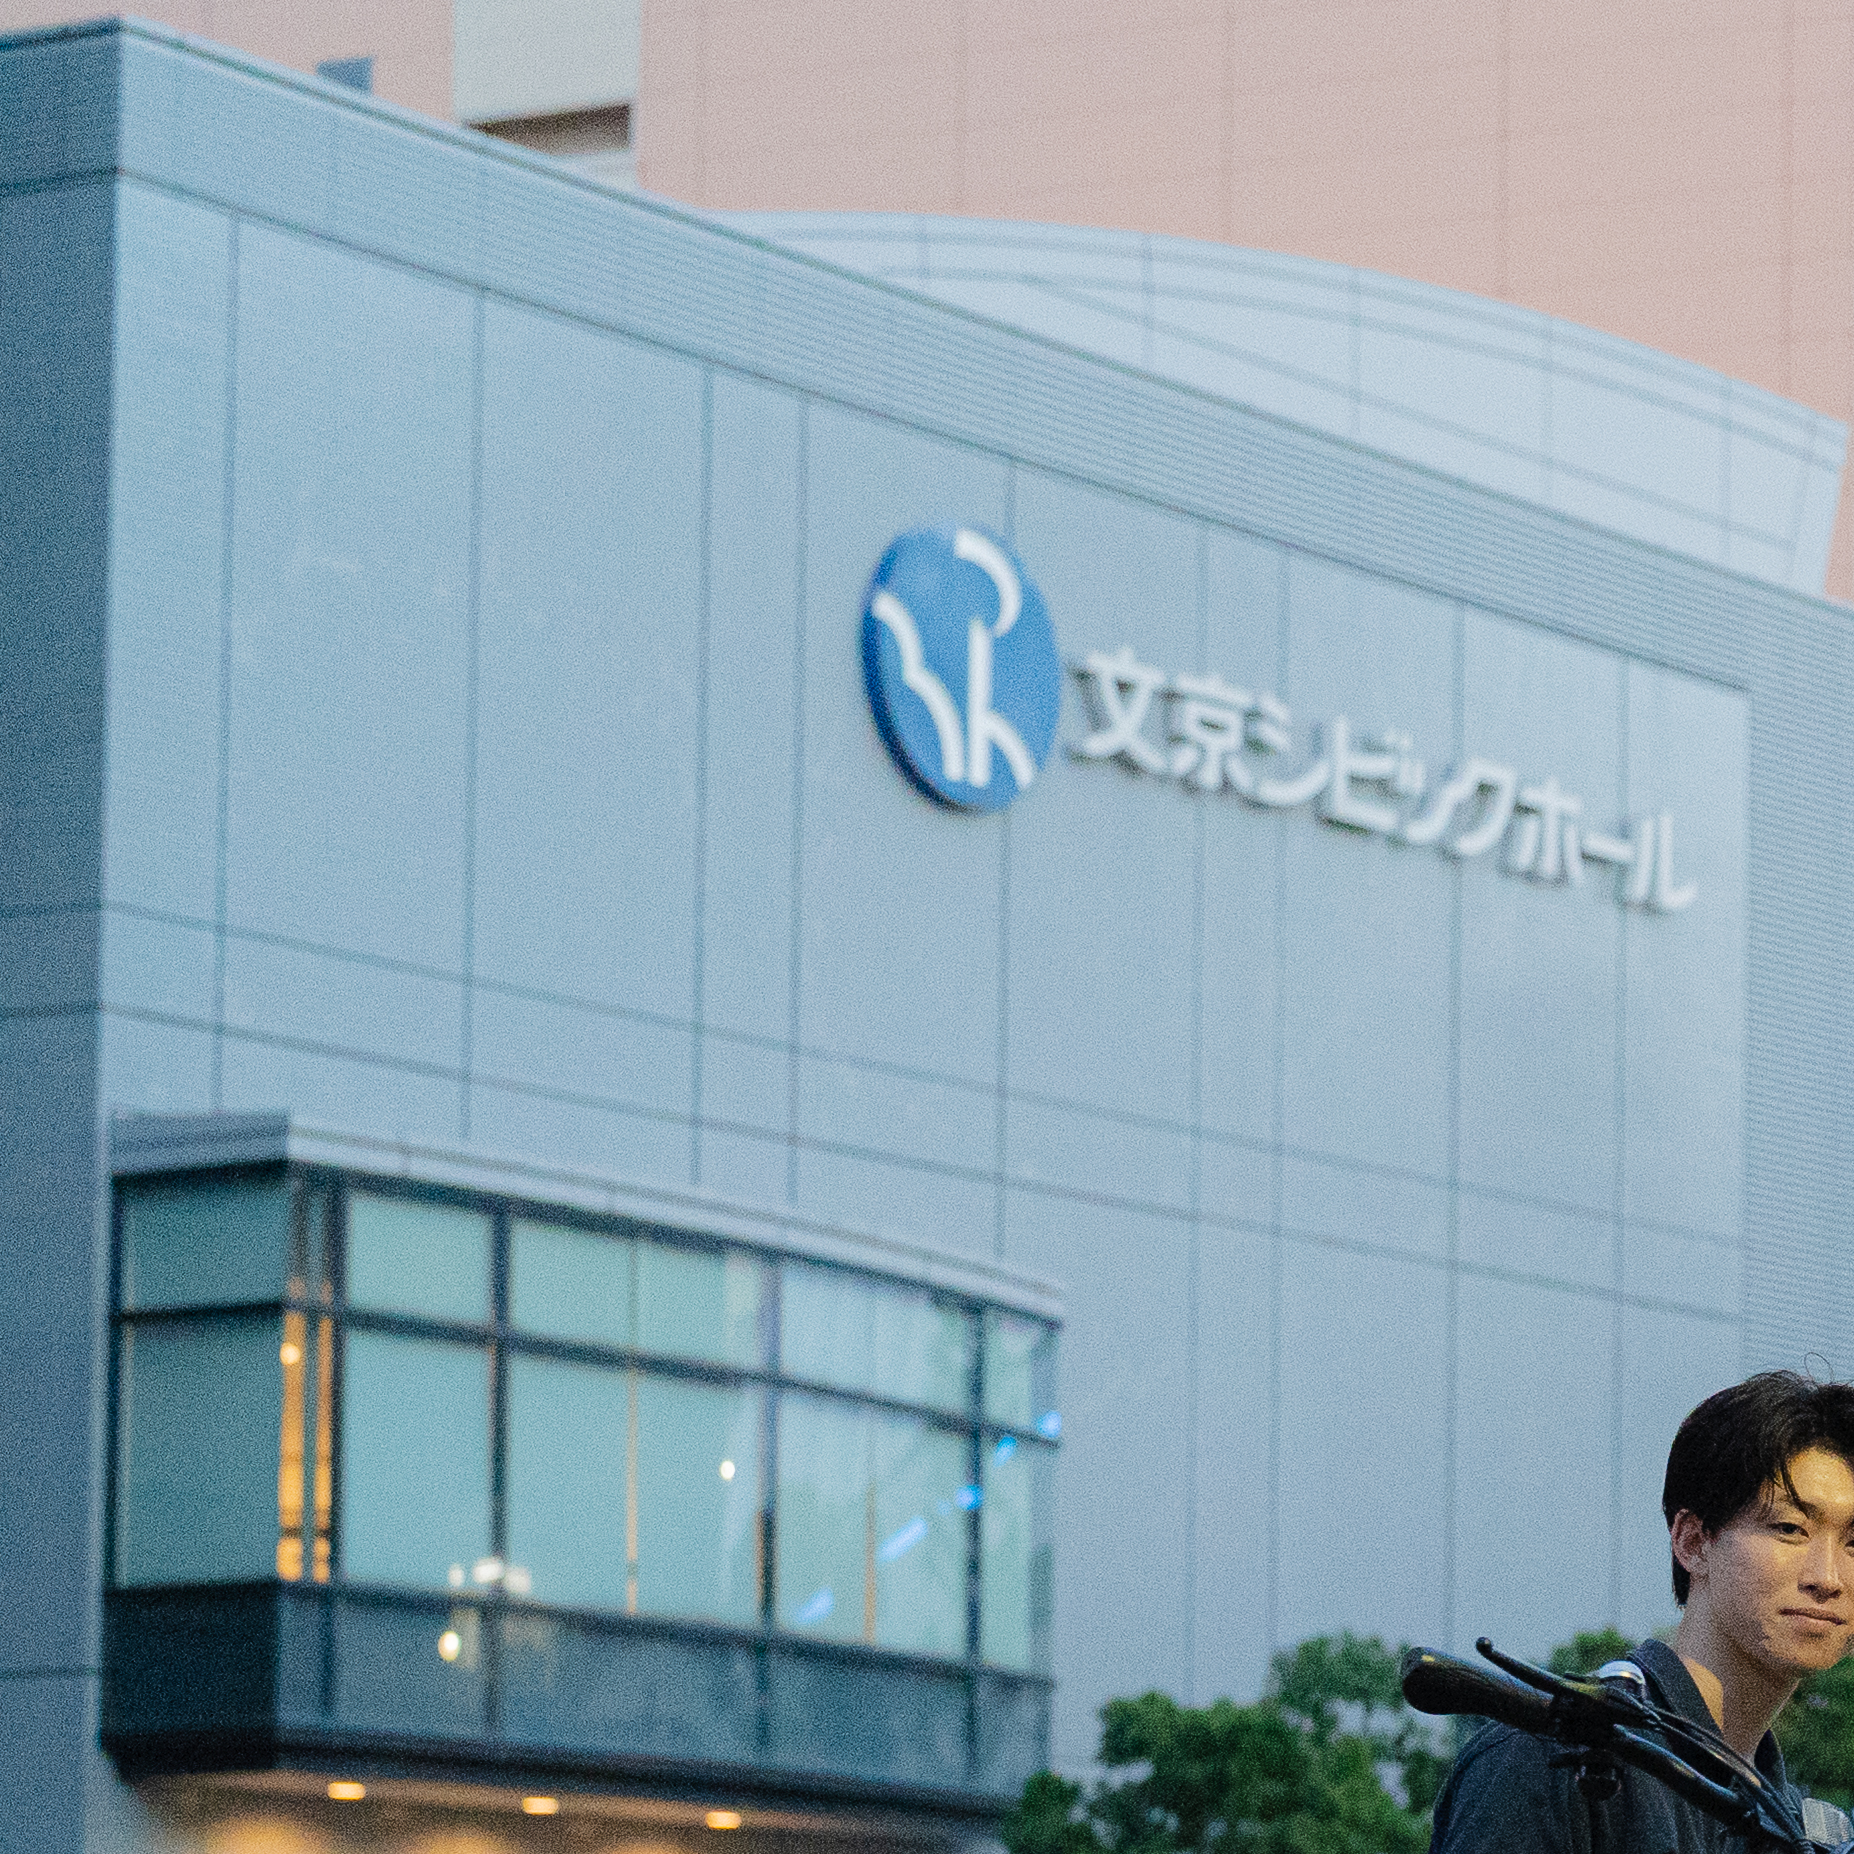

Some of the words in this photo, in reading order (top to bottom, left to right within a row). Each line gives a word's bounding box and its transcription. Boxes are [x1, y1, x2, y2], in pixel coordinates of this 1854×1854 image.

[1078, 648, 1696, 912] 文京シビックホール
